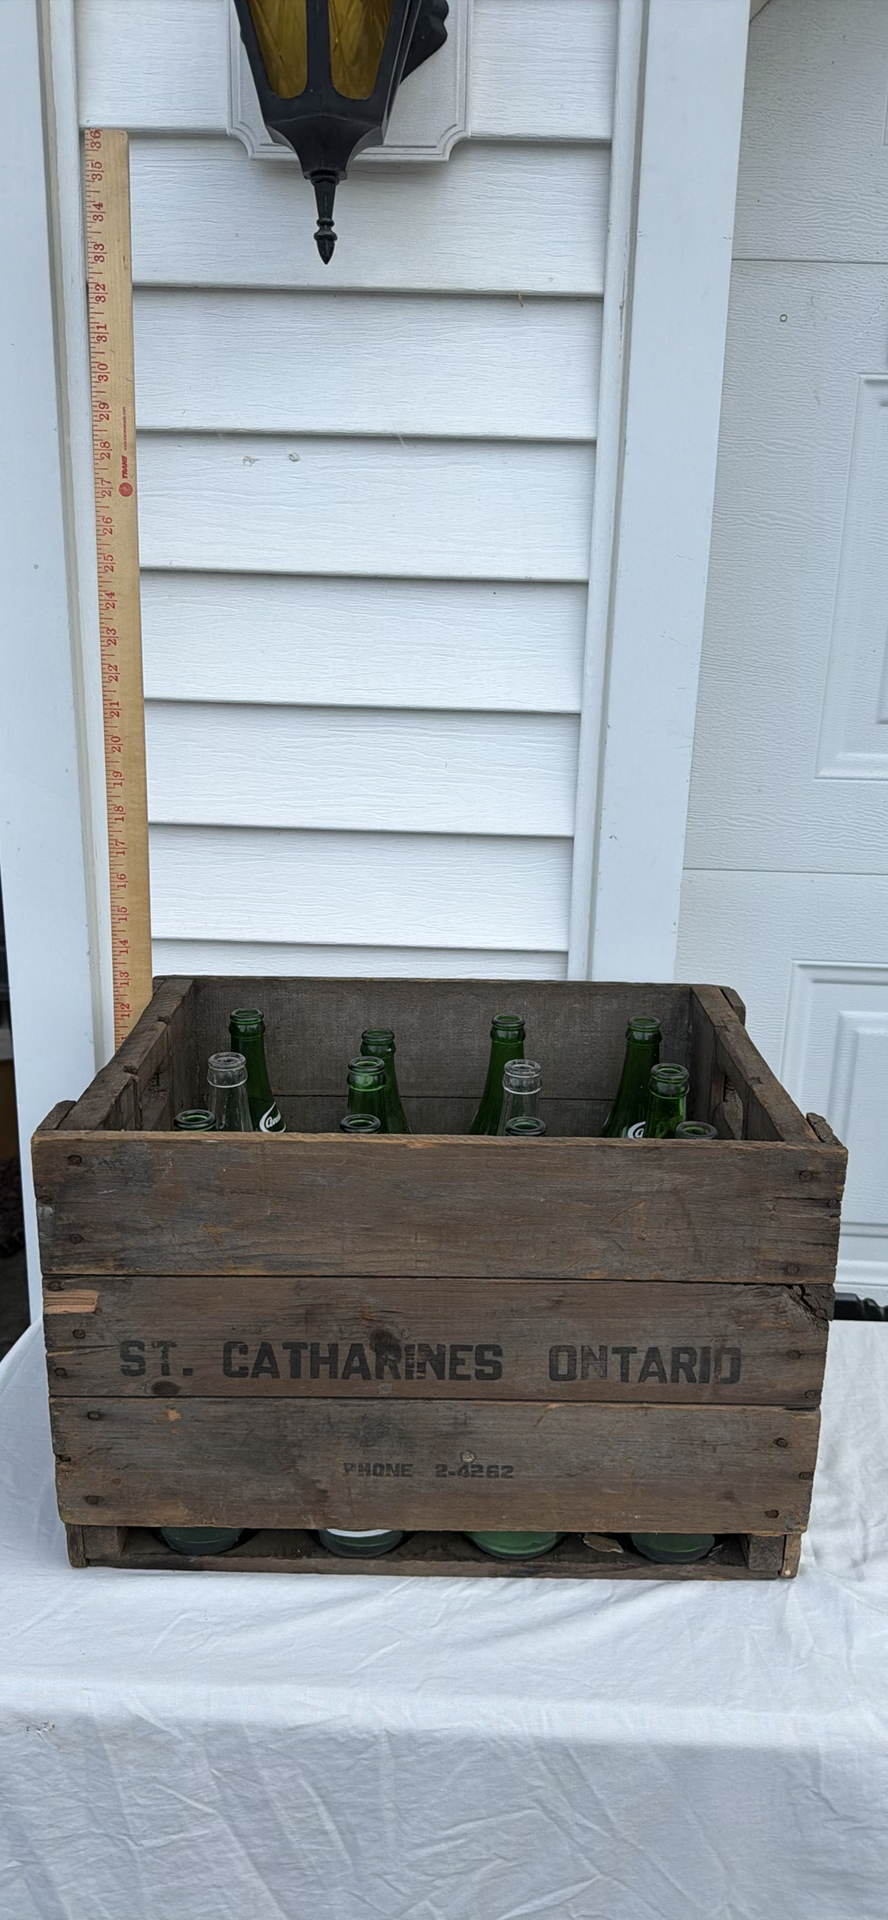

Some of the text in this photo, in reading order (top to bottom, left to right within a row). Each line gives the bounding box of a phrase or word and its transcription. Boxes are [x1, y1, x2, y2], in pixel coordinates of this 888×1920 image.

[90, 130, 102, 149] 36
[90, 161, 103, 181] 35
[92, 202, 103, 222] 34
[93, 243, 105, 263] 33
[95, 283, 106, 303] 32
[96, 324, 107, 343] 31
[97, 362, 109, 382] 30
[98, 402, 110, 421] 29
[99, 440, 111, 459] 28
[101, 478, 112, 497] 27
[102, 516, 113, 535] 26
[103, 554, 115, 572] 25
[104, 591, 116, 609] 24
[105, 627, 117, 646] 23
[107, 664, 119, 682] 22
[108, 701, 120, 718] 21
[110, 735, 121, 753] 20
[111, 770, 123, 787] 19
[113, 805, 125, 822] 18
[114, 840, 126, 856] 17
[116, 873, 127, 889] 16
[117, 906, 128, 922] 15
[118, 939, 129, 954] 14
[119, 971, 130, 987] 13
[120, 1003, 131, 1019] 12
[120, 1340, 742, 1385] ST. CATHARINES ONTARIO
[343, 1462, 514, 1479] PHONE 2-4262
